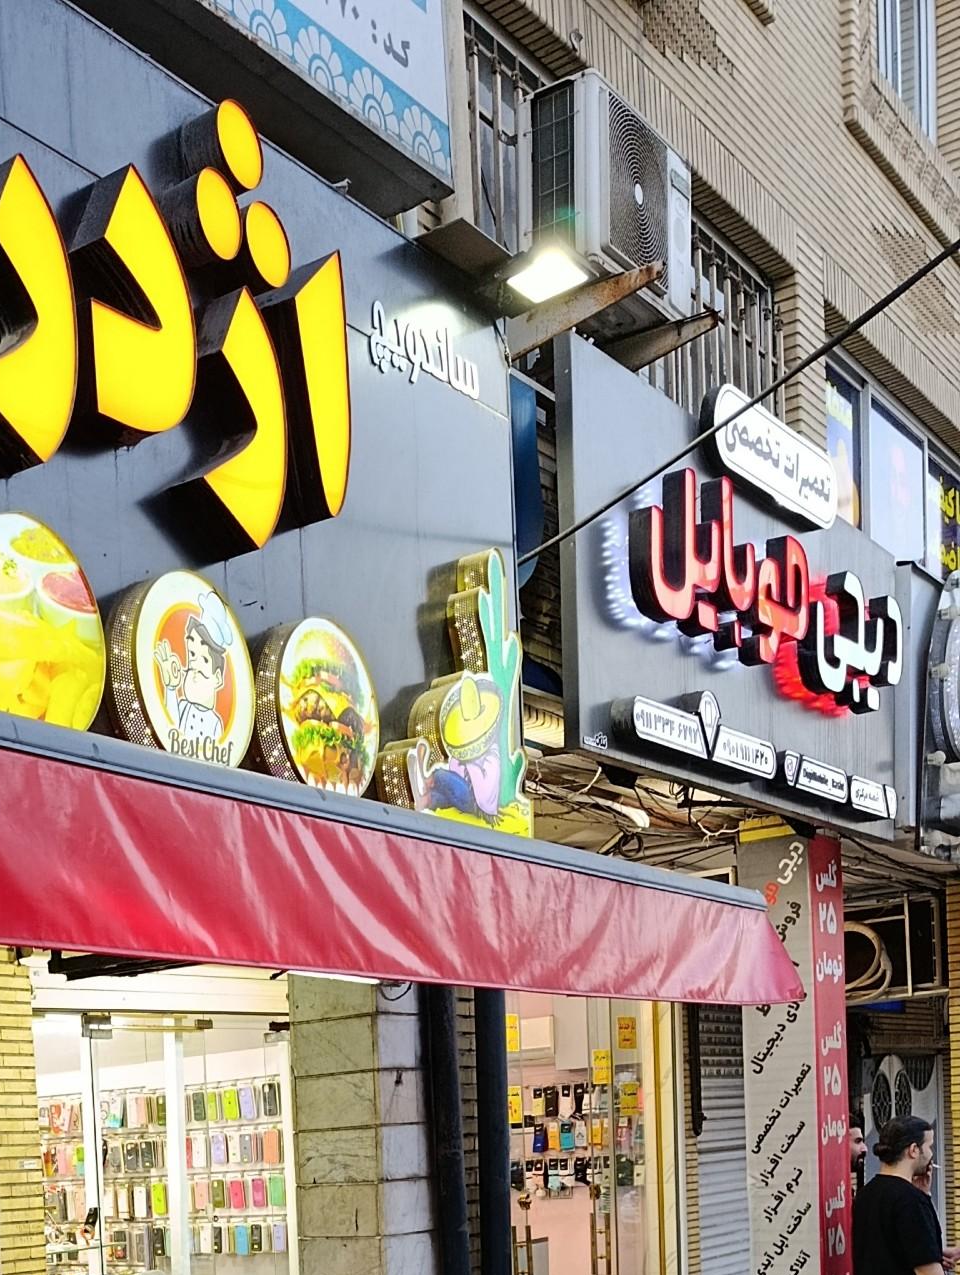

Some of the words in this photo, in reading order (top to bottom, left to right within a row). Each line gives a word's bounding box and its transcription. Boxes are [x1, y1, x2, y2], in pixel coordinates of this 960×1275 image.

[725, 422, 780, 469] تخصصی
[784, 453, 831, 503] تعمیرات
[650, 468, 809, 664] موبایل
[816, 570, 904, 711] دیجی
[168, 728, 201, 762] Best
[202, 730, 234, 768] Chef
[777, 841, 804, 885] دیجی
[815, 859, 837, 893] گلس
[818, 901, 837, 935] ۲۵
[816, 951, 843, 984] تومان
[751, 1023, 786, 1074] دیجیتال
[821, 1020, 842, 1056] گلس
[779, 1063, 811, 1108] تعمیرات
[823, 1062, 842, 1097] ۲۵
[751, 1109, 781, 1154] تخصصی
[780, 1121, 805, 1154] سخت
[821, 1113, 847, 1146] تومان
[760, 1153, 783, 1187] افزار
[786, 1167, 803, 1194] نرم
[763, 1190, 787, 1223] افزار
[825, 1180, 846, 1218] گلس
[786, 1202, 812, 1235] ساخت
[772, 1233, 789, 1256] اپل
[828, 1222, 846, 1257] ۲۵
